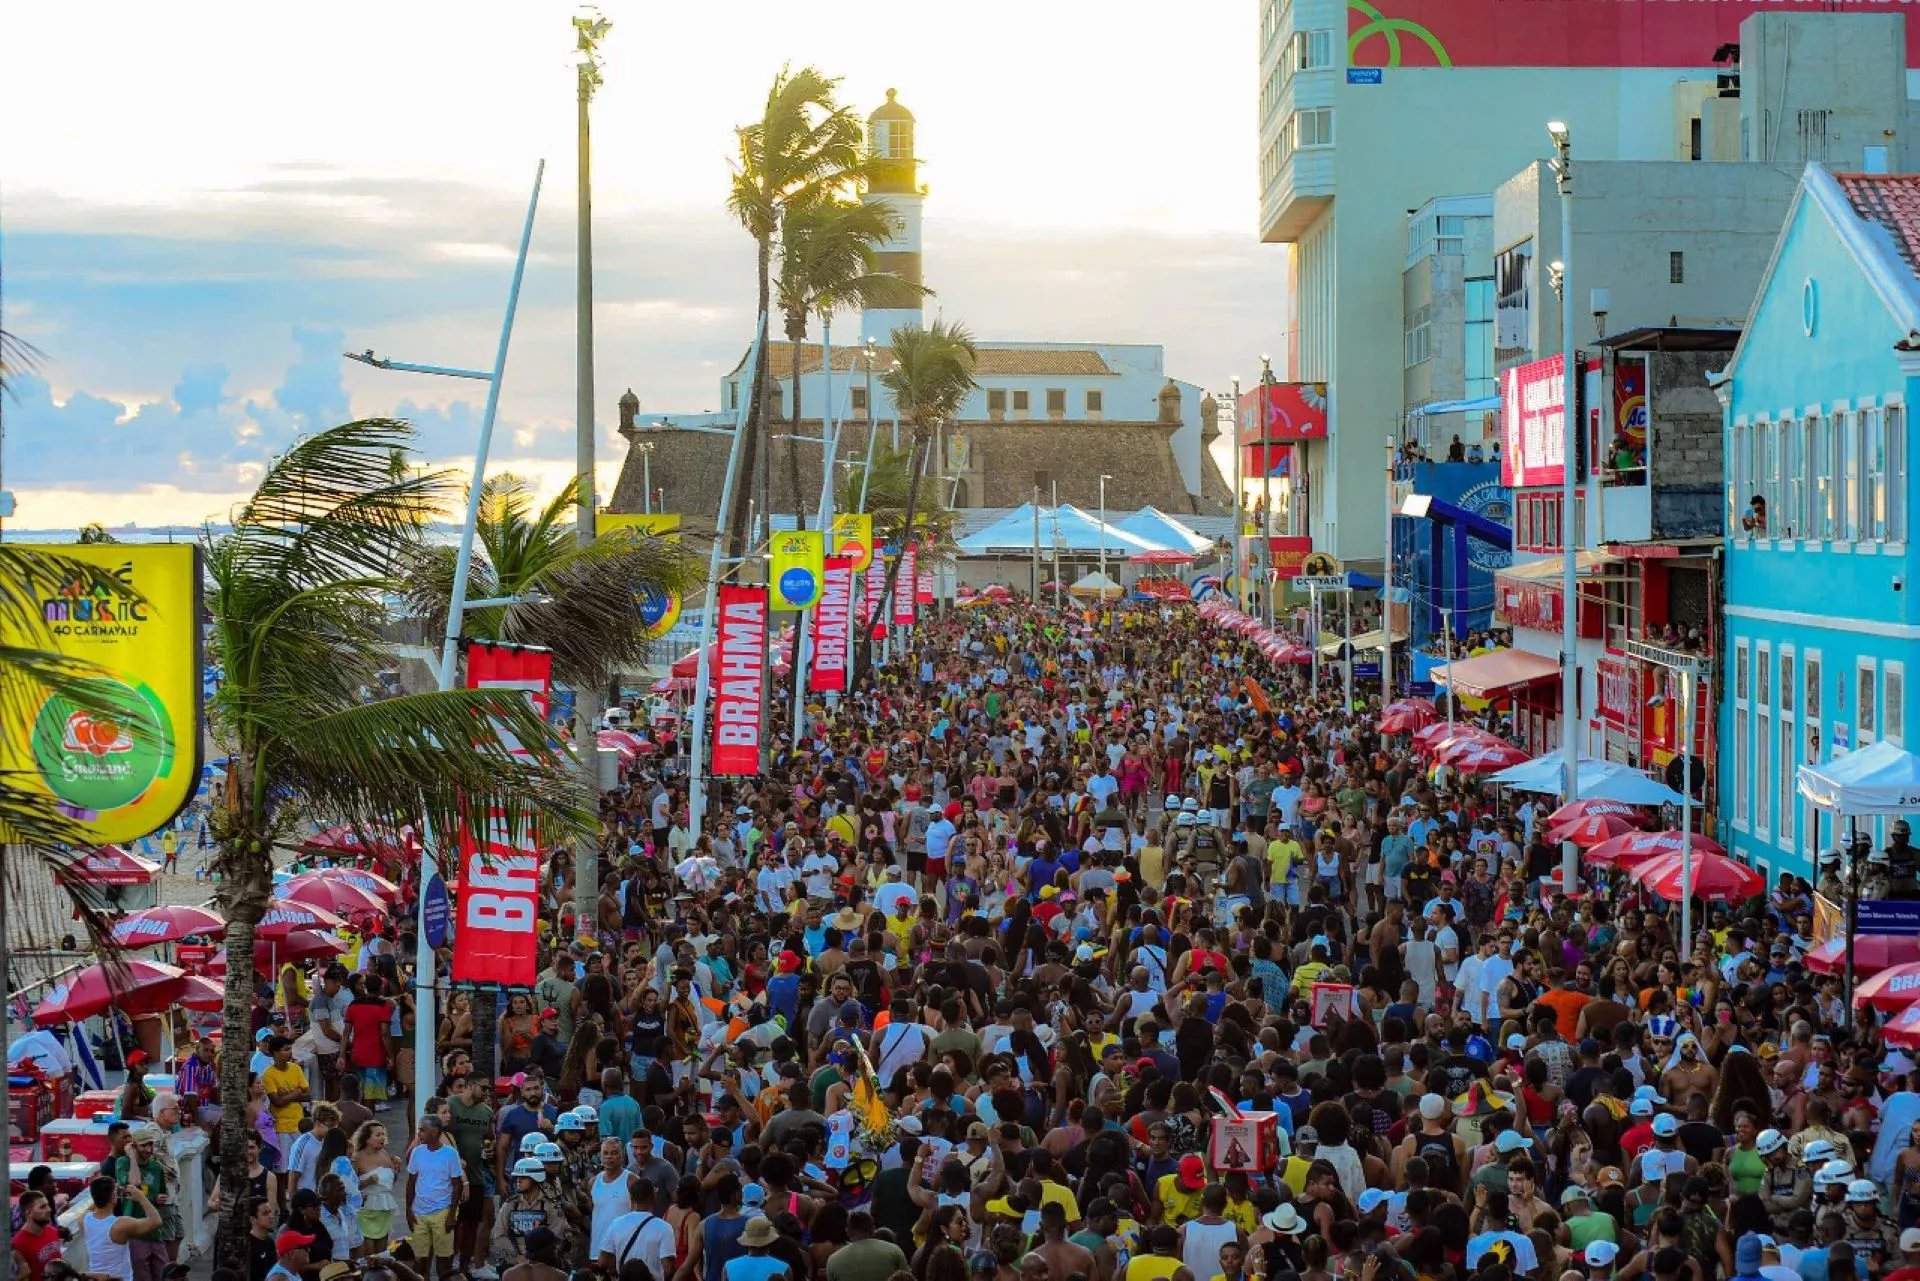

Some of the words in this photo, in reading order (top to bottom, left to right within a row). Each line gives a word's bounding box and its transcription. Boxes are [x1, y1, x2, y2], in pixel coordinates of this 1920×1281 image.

[54, 626, 72, 636] 40
[74, 626, 138, 636] CARNAVAIS
[815, 566, 851, 671] BRAHMA
[719, 602, 764, 746] BRAHMA
